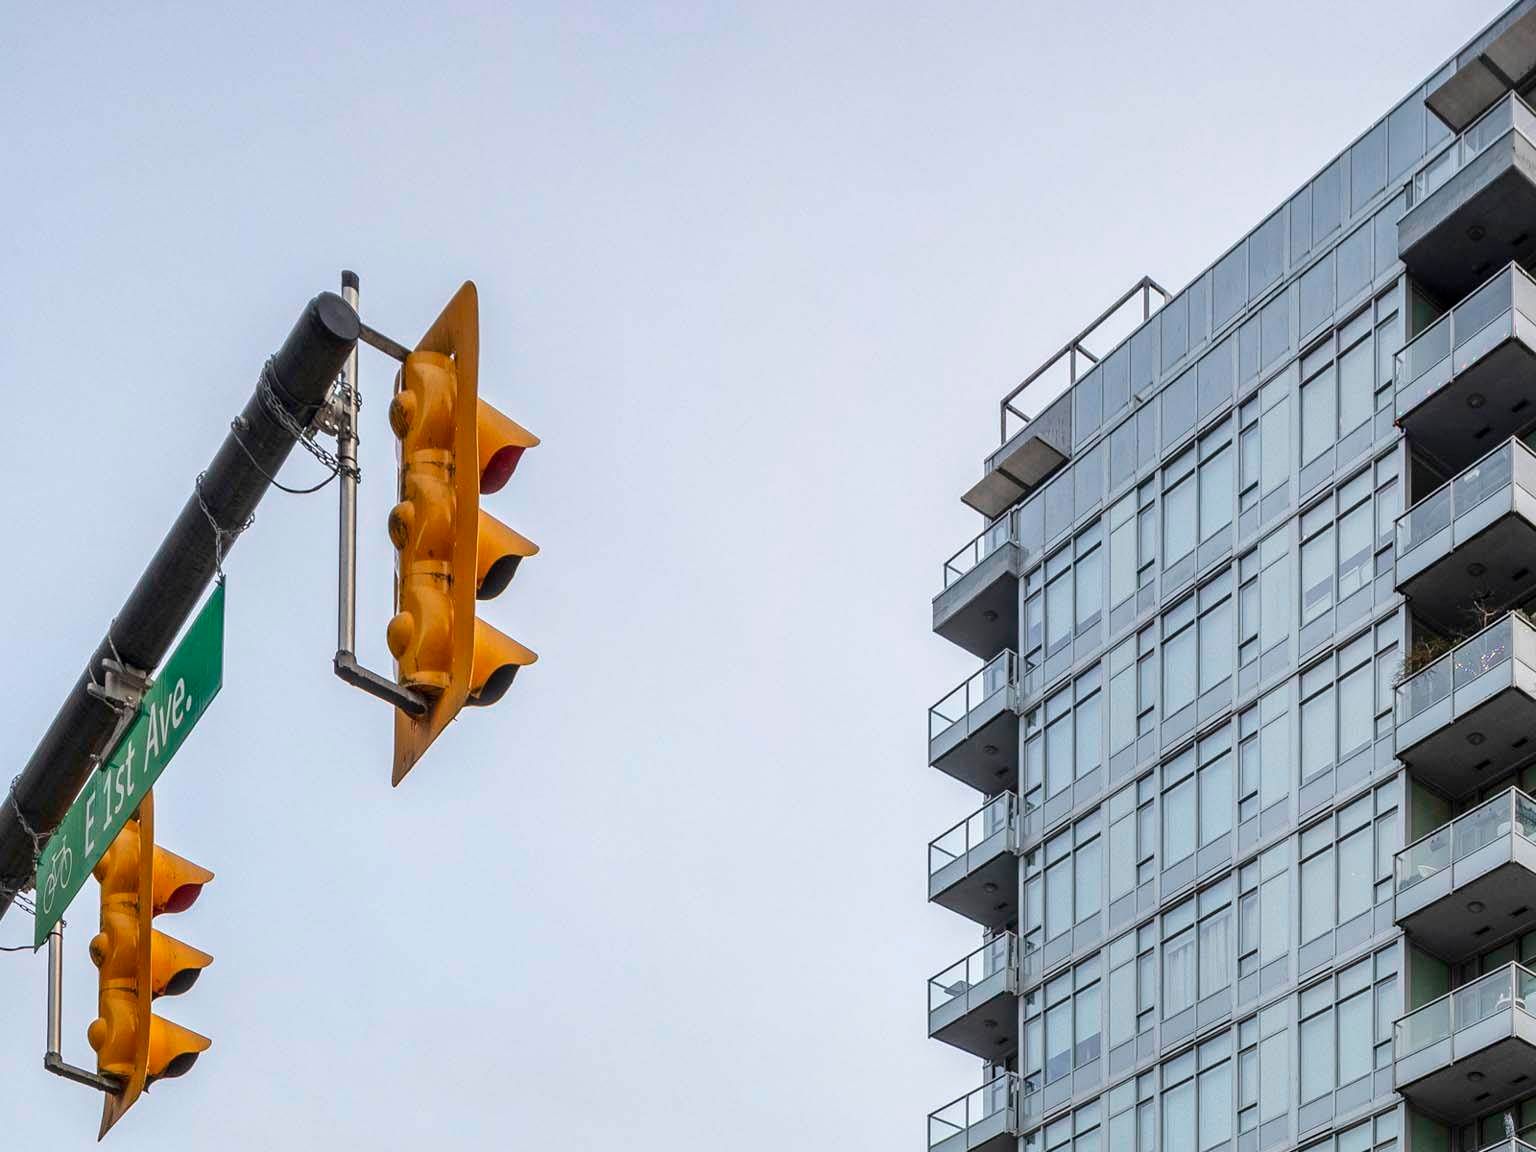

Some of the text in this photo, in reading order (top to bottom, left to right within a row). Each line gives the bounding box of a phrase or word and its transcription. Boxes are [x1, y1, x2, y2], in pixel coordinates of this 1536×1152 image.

[83, 677, 193, 857] E 1st Ave.
